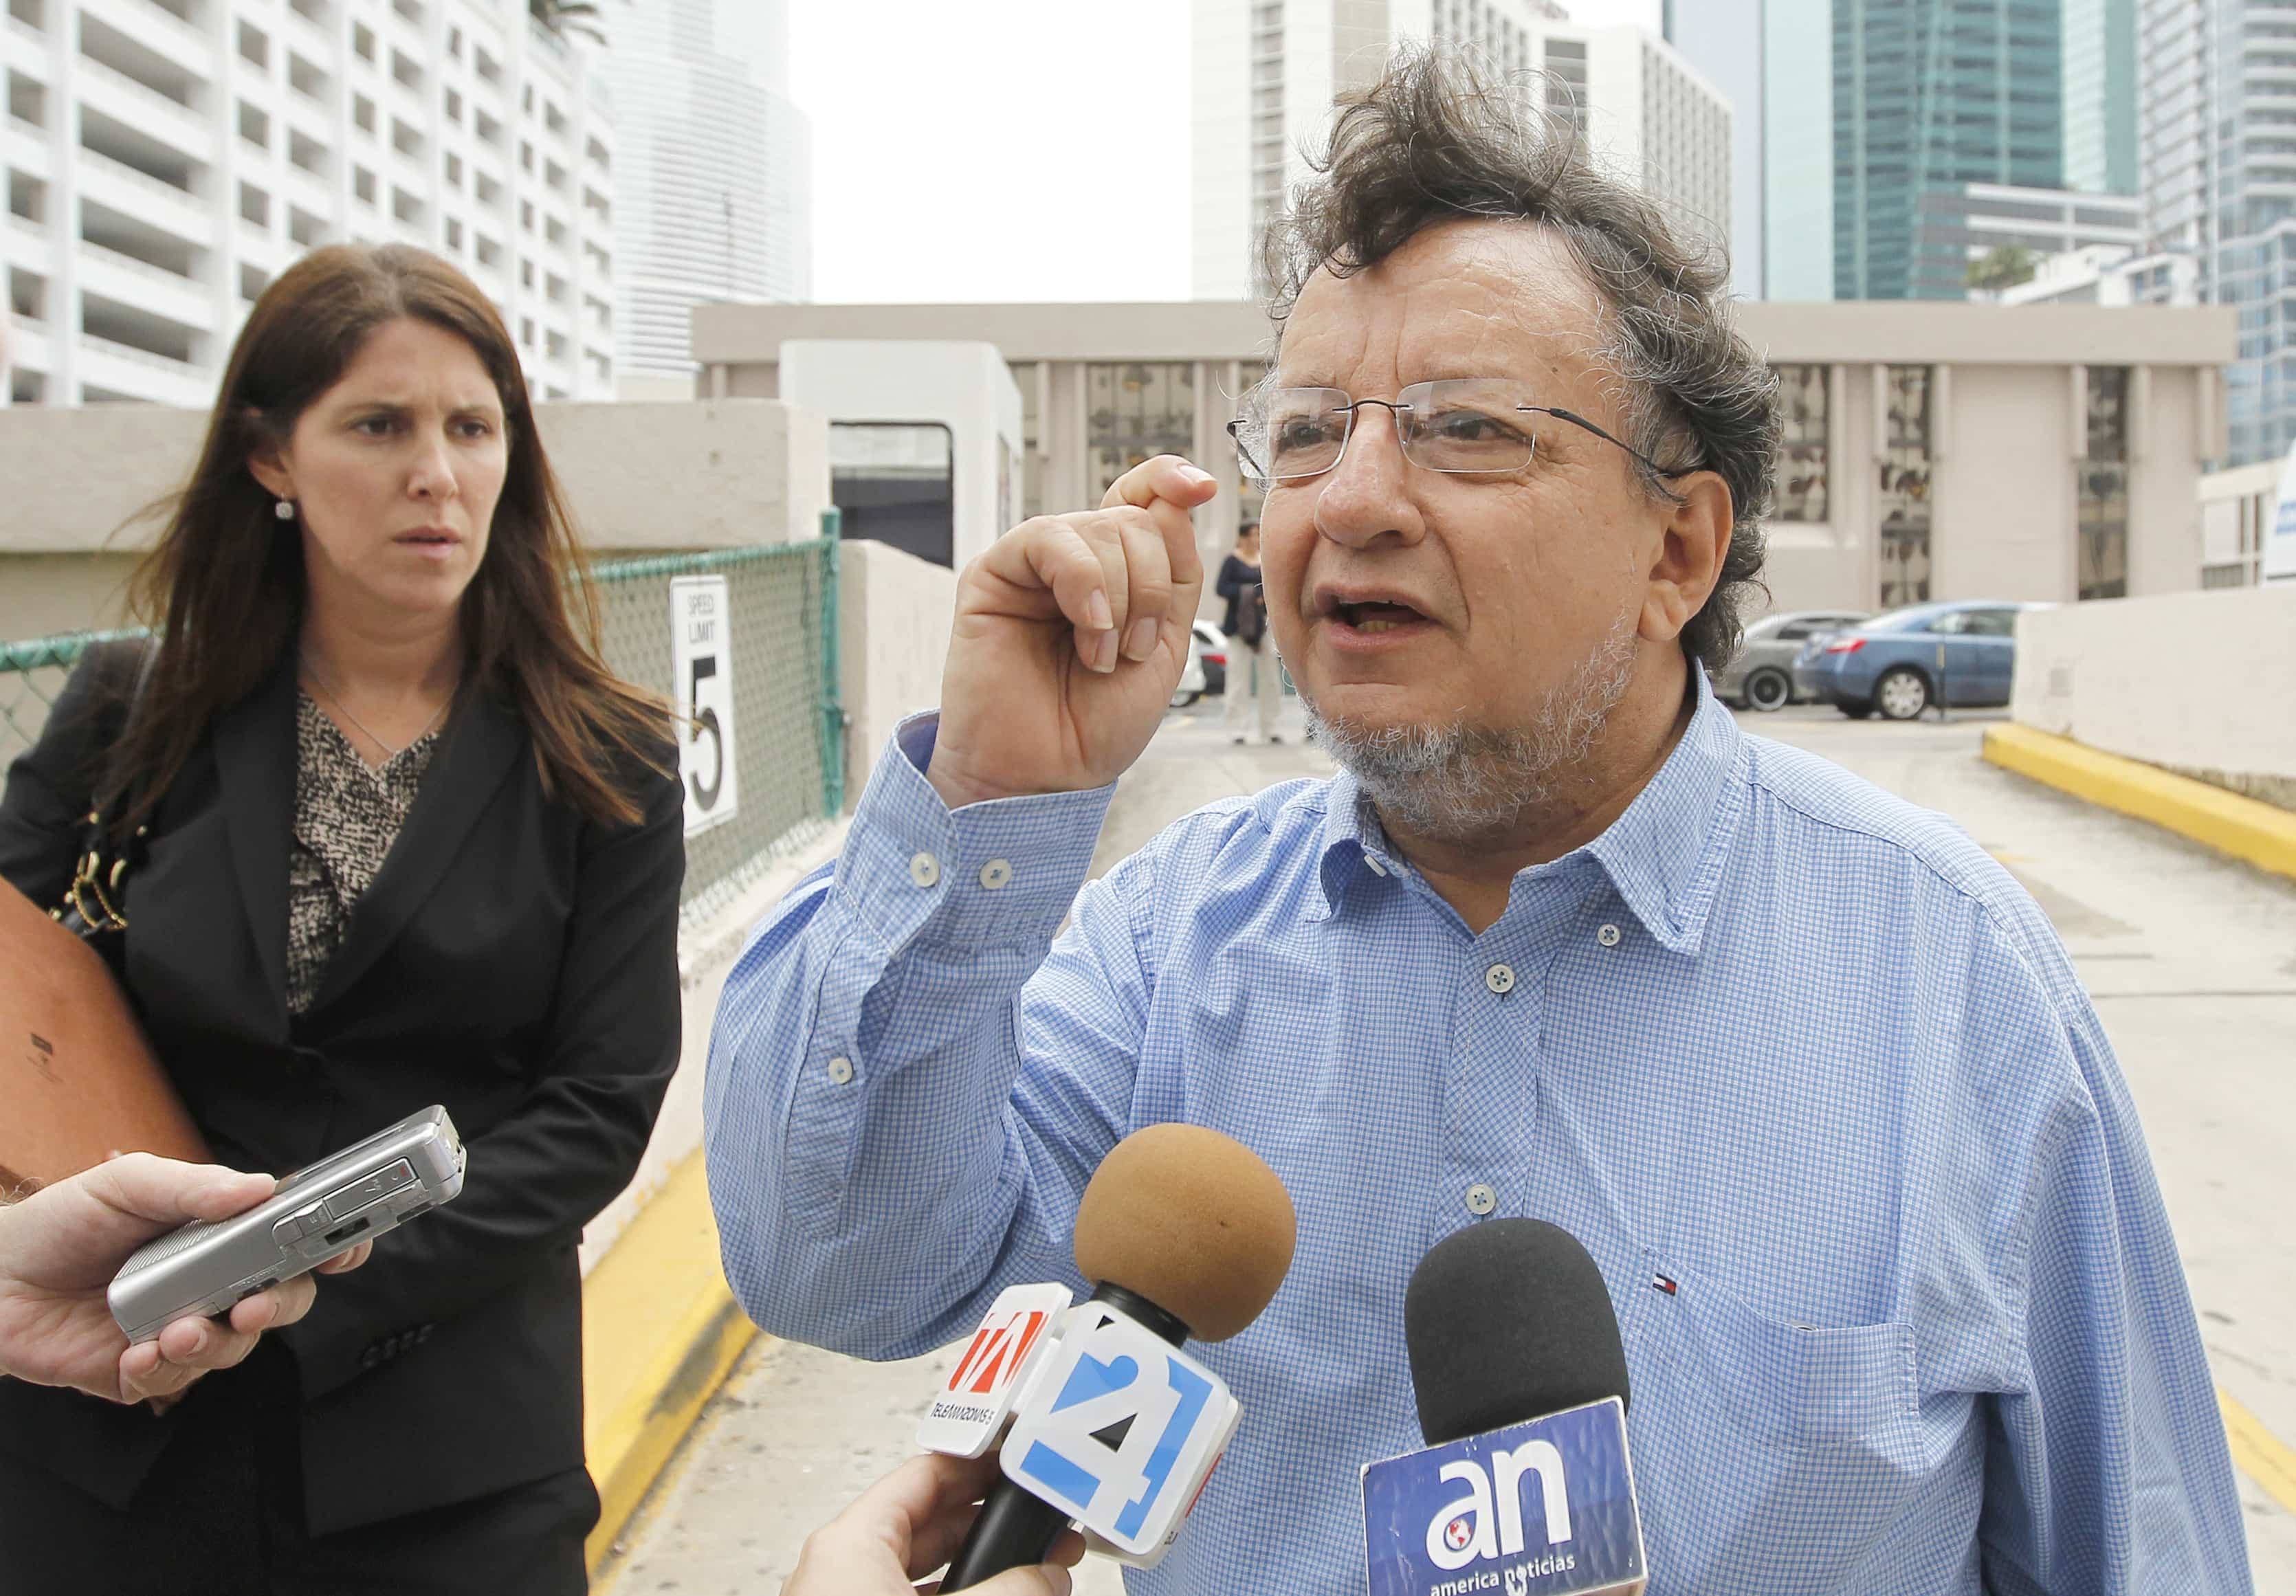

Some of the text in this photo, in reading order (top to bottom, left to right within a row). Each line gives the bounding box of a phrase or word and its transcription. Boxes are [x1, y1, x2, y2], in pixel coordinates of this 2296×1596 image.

[688, 594, 714, 615] SPEED
[688, 620, 715, 644] LIMIT
[690, 655, 723, 812] 5
[1426, 1439, 1573, 1571] an
[1431, 1554, 1576, 1596] america noticias
